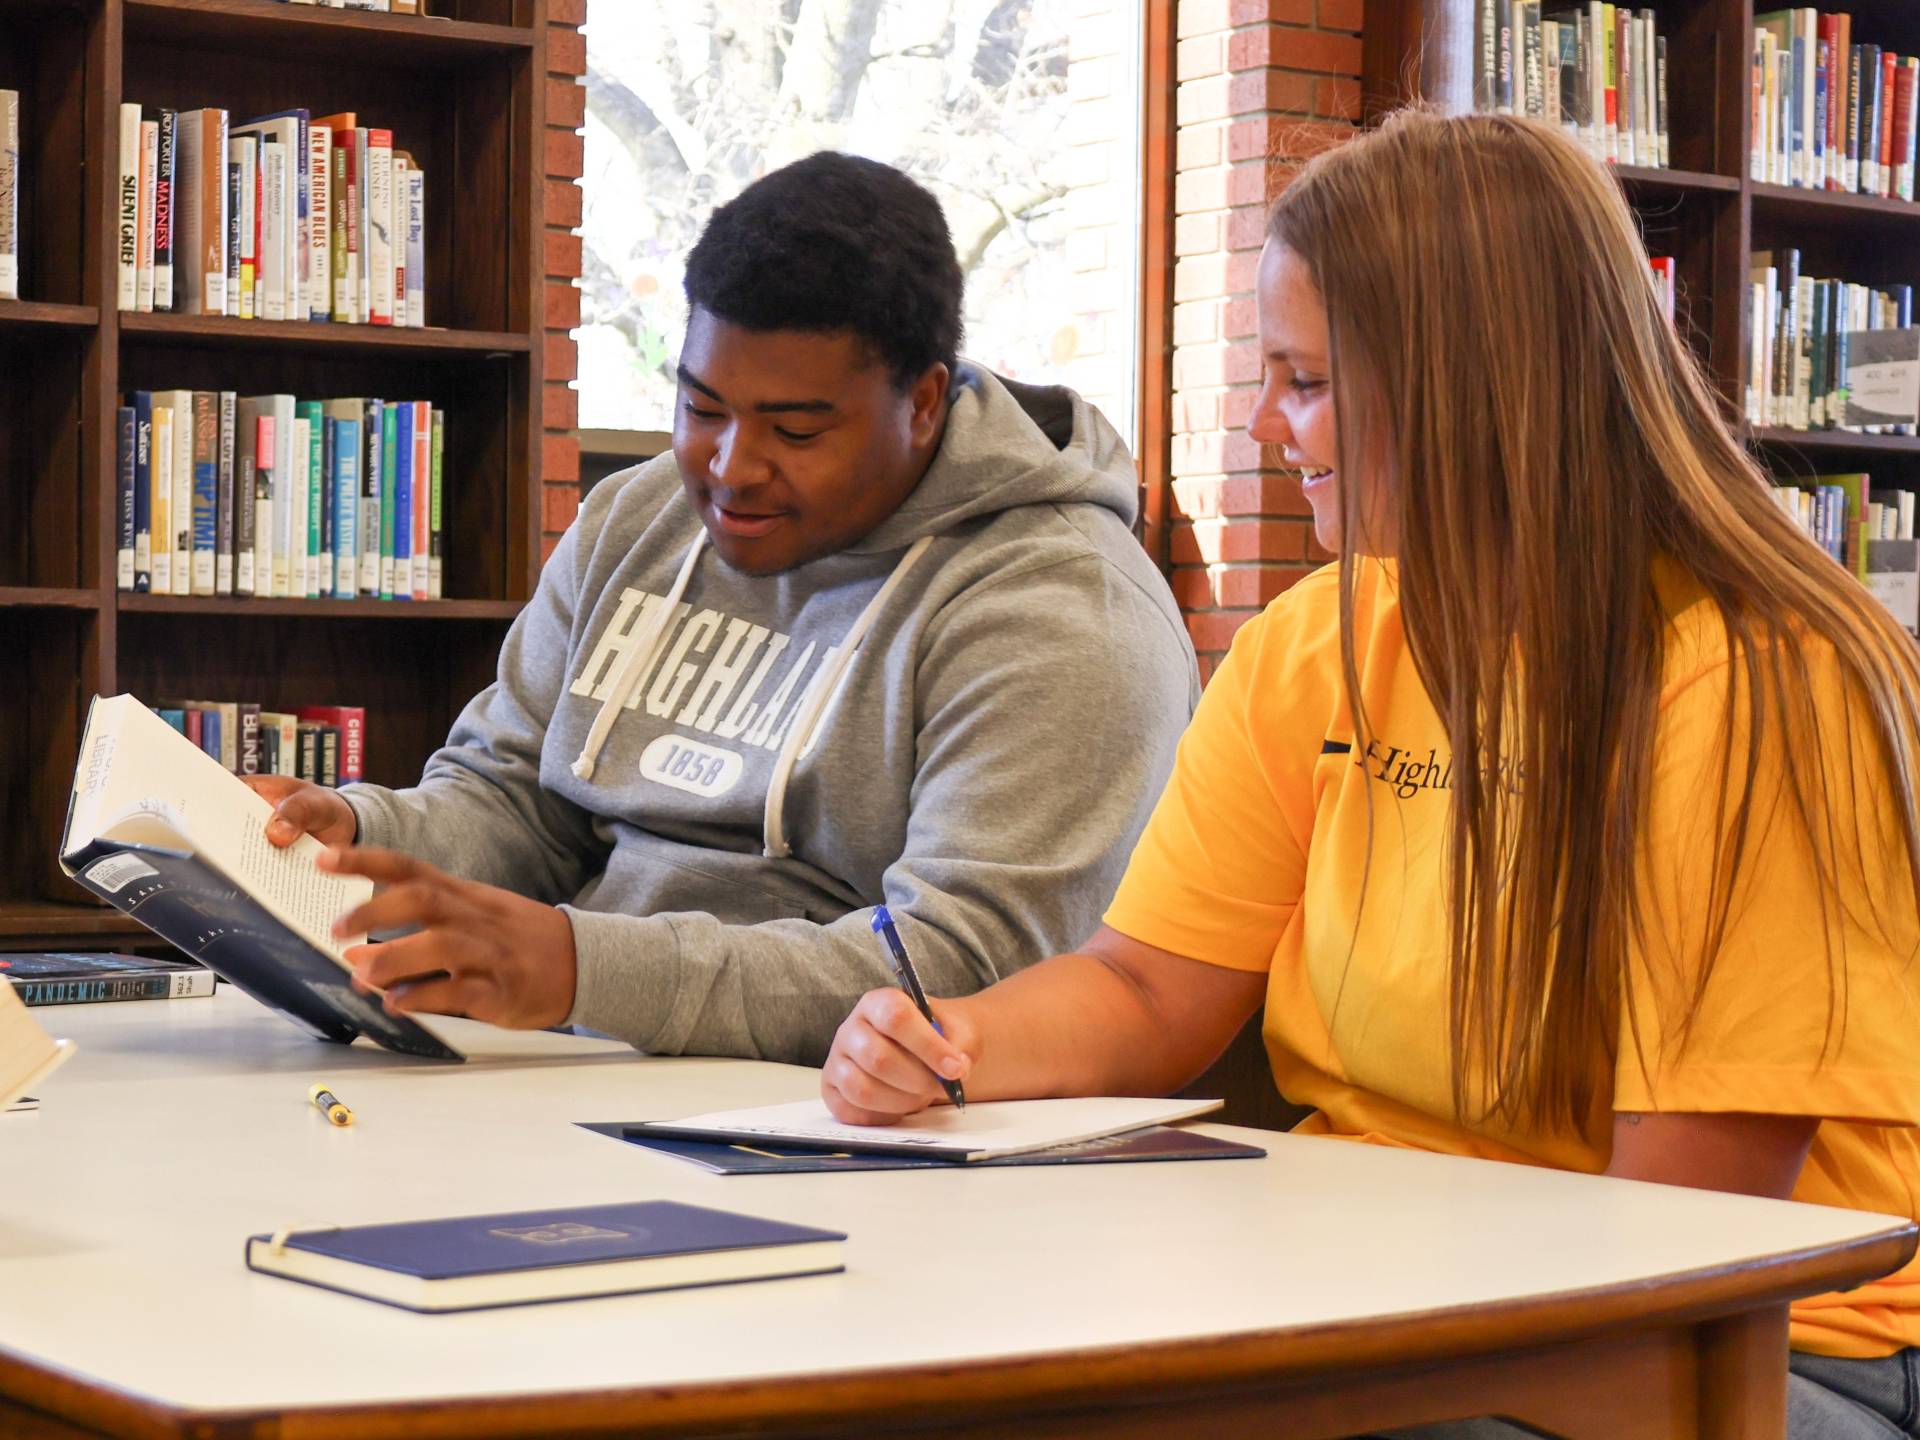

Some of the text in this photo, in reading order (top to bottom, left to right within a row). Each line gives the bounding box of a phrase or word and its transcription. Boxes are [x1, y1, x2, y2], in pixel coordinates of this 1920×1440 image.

[1499, 27, 1512, 82] Our Guys
[160, 112, 172, 177] ROY PORTER
[312, 131, 326, 248] NEW AMERICAN BLUES
[373, 153, 381, 200] STONES
[121, 175, 136, 268] SILENT GRIEF
[156, 181, 171, 250] MADNESS
[406, 177, 421, 243] The Lost Boy
[193, 462, 216, 552] NAP TIME
[243, 714, 259, 775] BLIND
[347, 719, 360, 773] CHOICE
[657, 744, 725, 786] 1858
[25, 980, 107, 1003] PANDEMIC
[177, 975, 185, 996] 362.1
